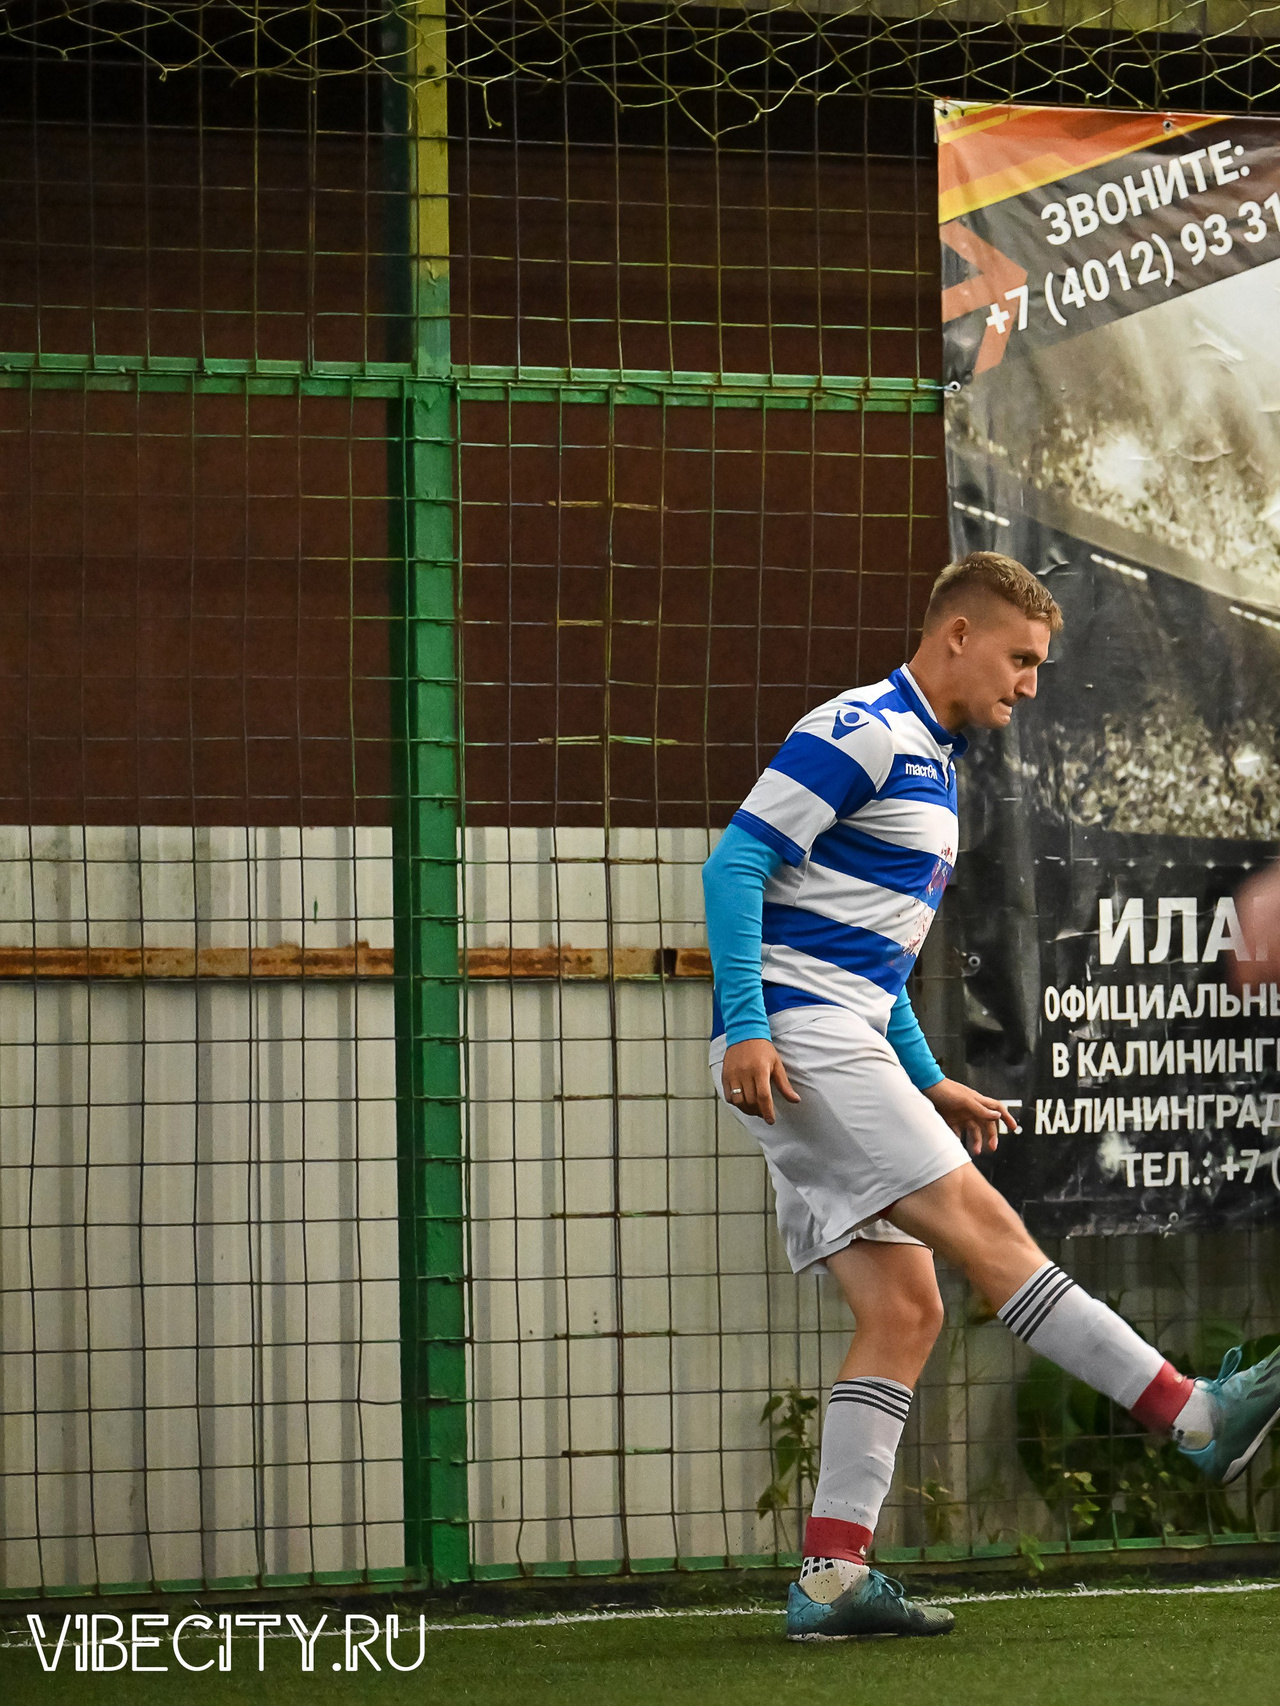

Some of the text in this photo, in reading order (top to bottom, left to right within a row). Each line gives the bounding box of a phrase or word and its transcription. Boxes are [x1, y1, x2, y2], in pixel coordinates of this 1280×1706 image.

[1040, 139, 1251, 246] ЗВОНИТЕ:
[985, 285, 1029, 334] +7
[1044, 233, 1176, 326] (4012)
[1180, 214, 1234, 265] 93
[905, 762, 938, 780] macron
[1052, 1041, 1070, 1078] В
[1120, 1151, 1211, 1188] ТЕЛ.:
[1221, 1148, 1261, 1184] +7
